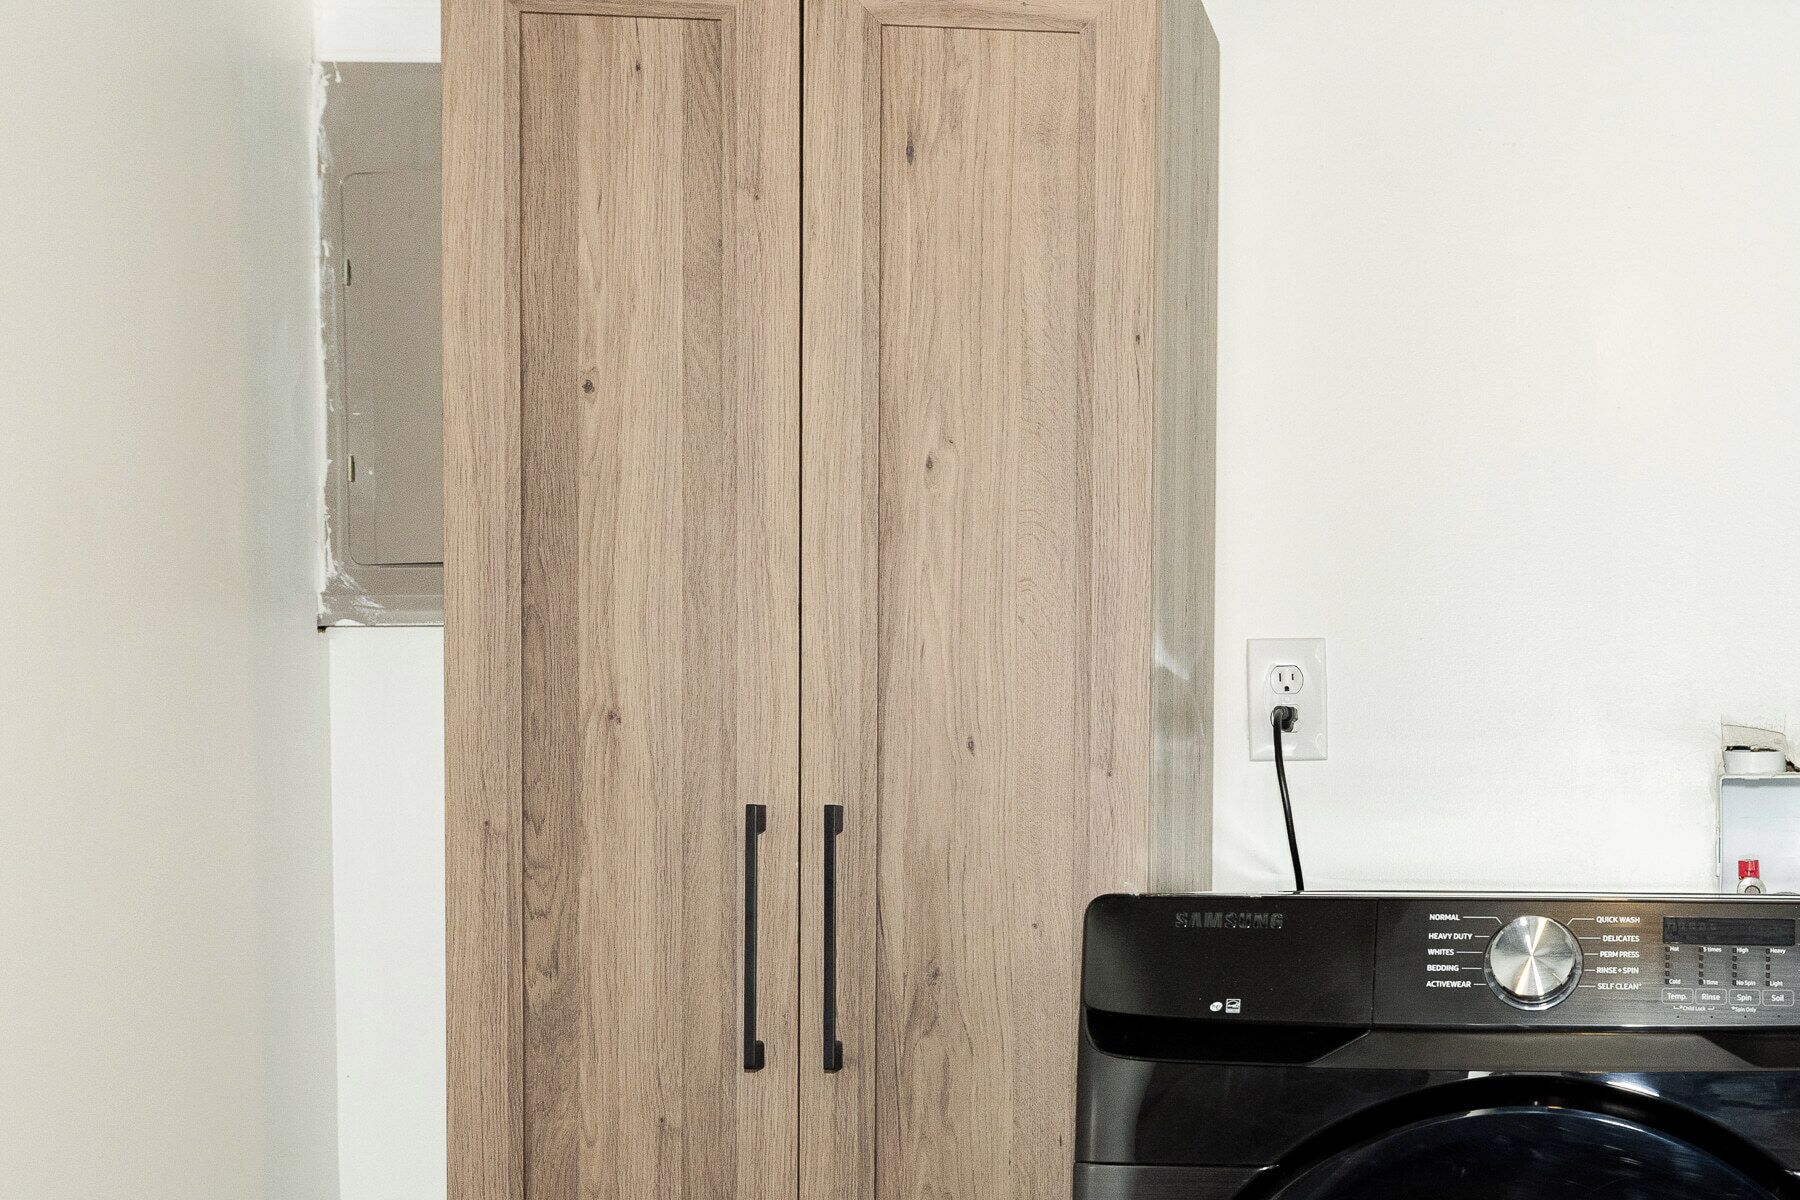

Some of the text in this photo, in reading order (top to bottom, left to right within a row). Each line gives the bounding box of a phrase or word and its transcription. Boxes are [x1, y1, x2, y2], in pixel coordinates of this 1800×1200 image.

[1175, 912, 1283, 929] SAMSUNG
[1667, 993, 1688, 1001] Temp.
[1701, 993, 1721, 1001] Rinse
[1737, 994, 1752, 1002] Spin
[1771, 994, 1785, 1002] Soil
